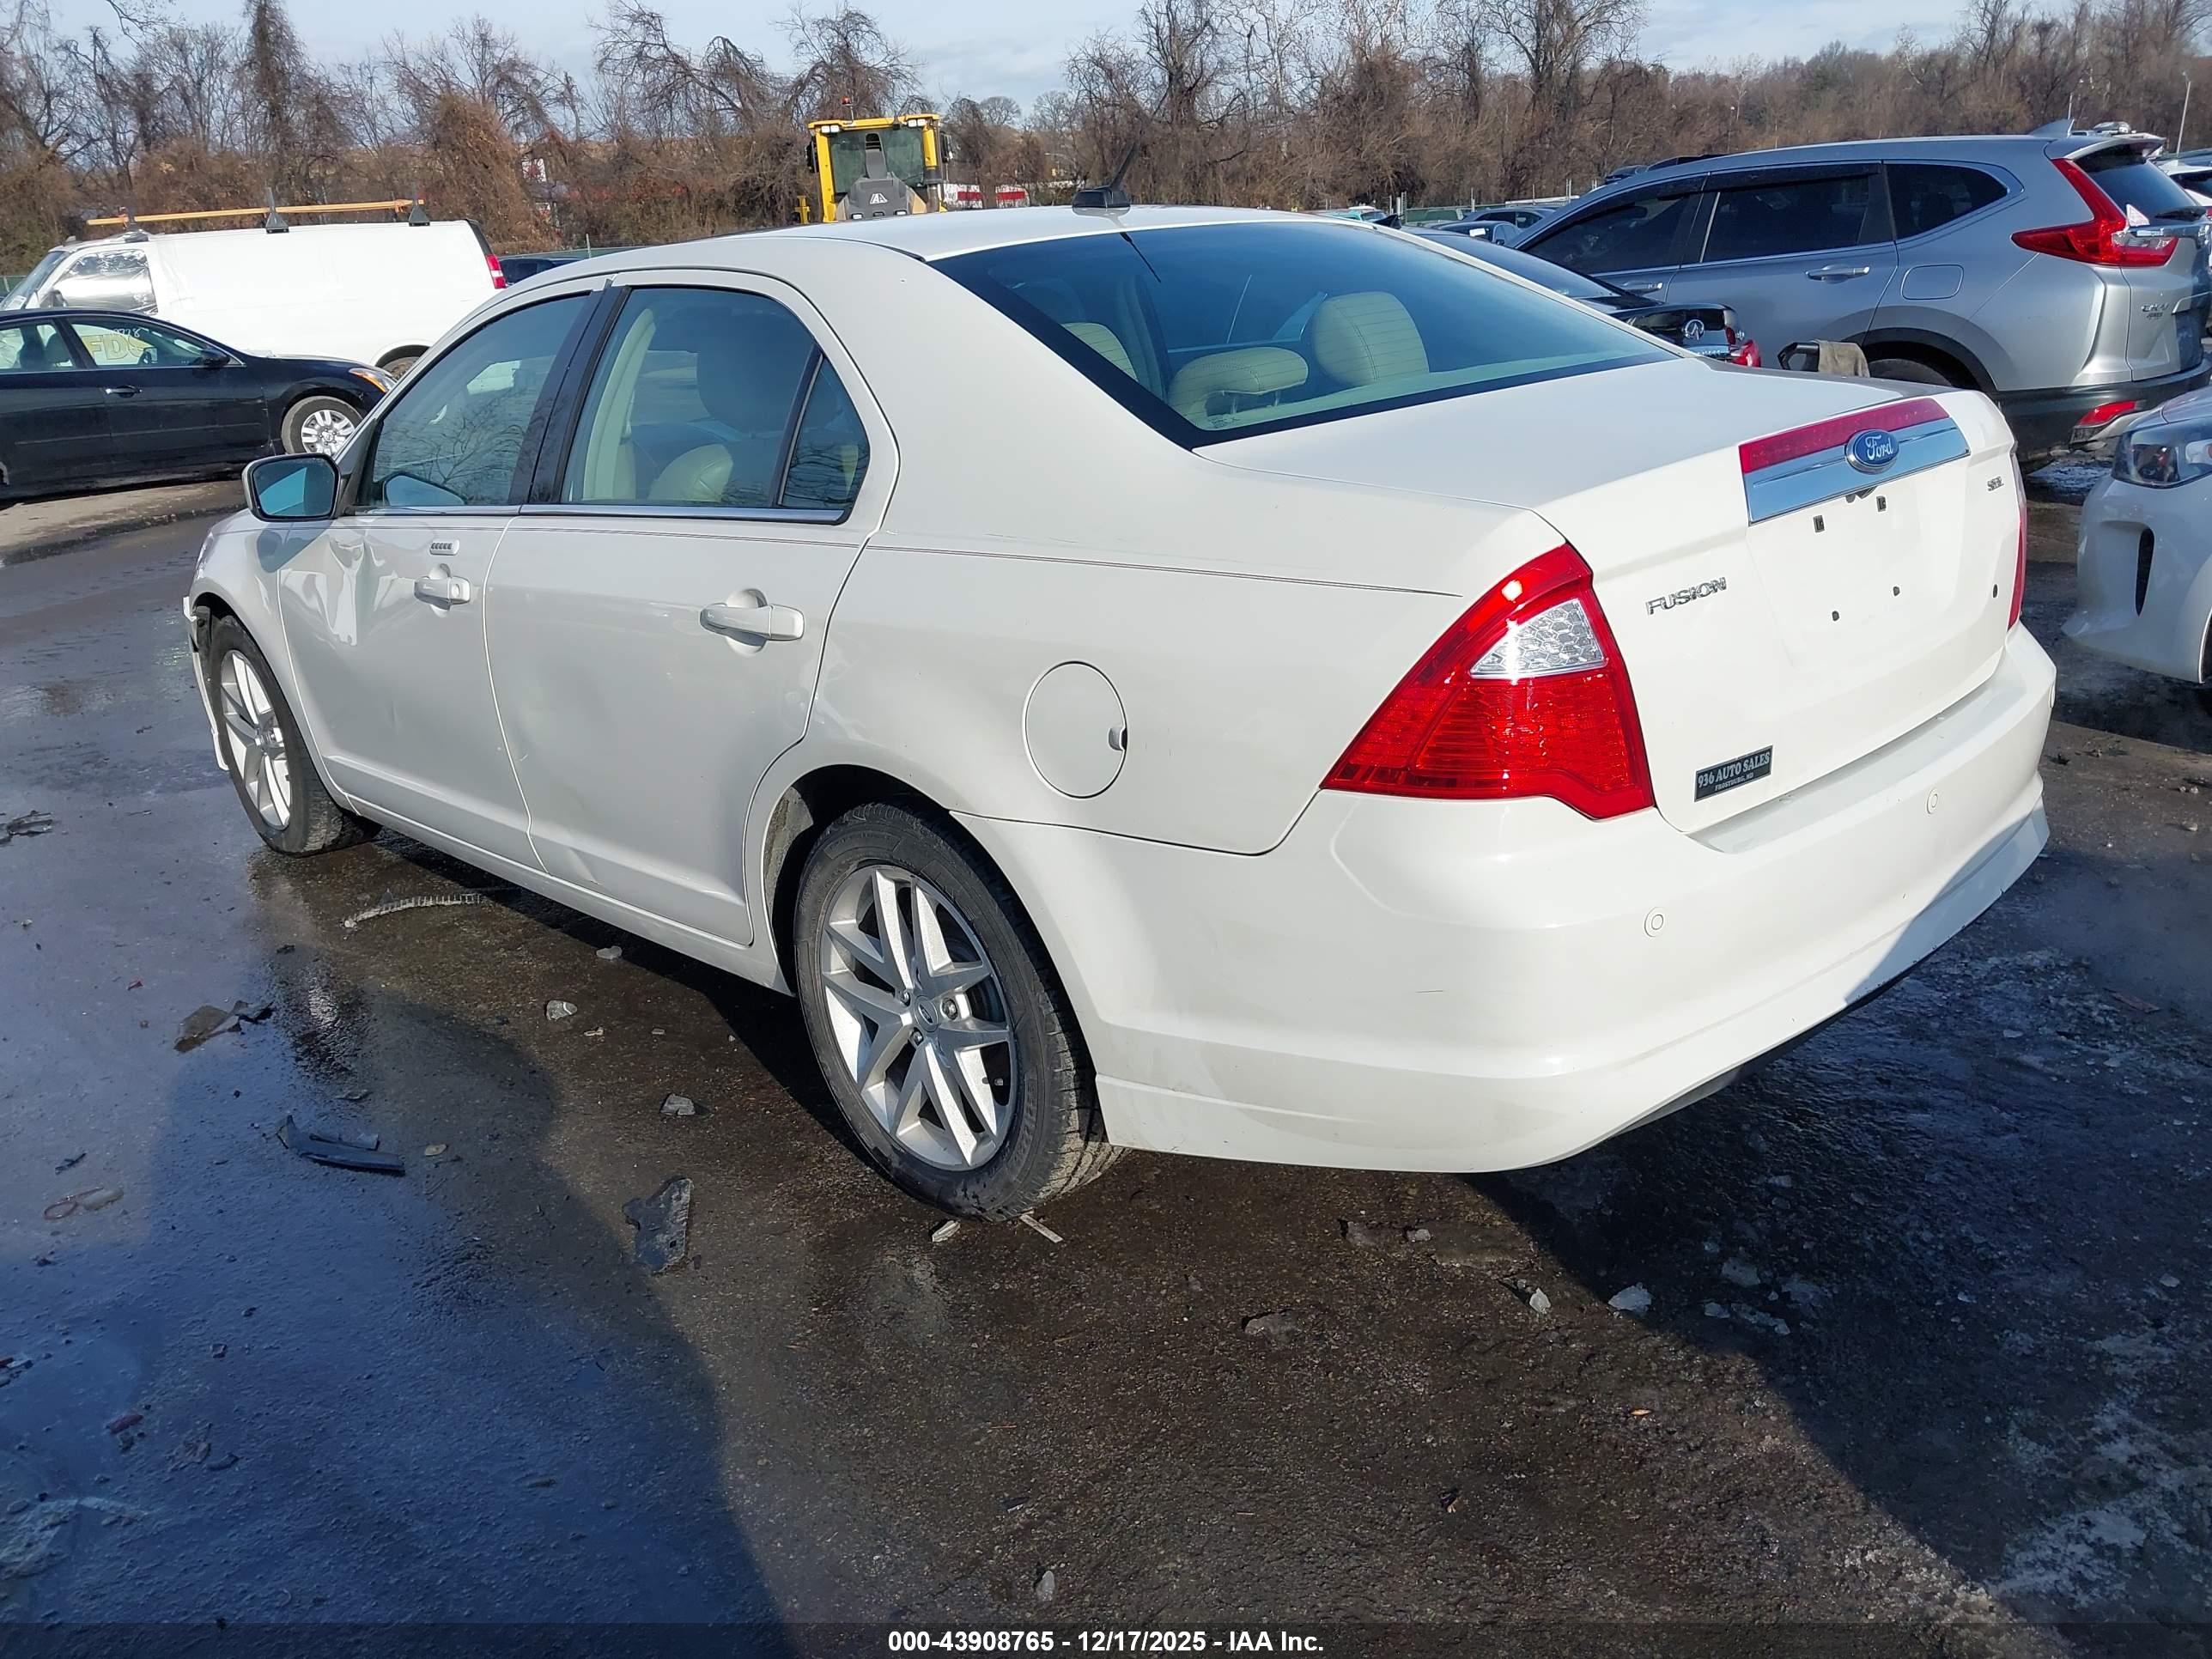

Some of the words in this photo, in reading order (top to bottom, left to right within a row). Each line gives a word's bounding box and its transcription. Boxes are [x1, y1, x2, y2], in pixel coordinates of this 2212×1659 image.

[1865, 434, 1893, 461] Ford
[1645, 576, 1727, 615] FUSION
[1698, 771, 1715, 788] 936
[1716, 762, 1741, 782] AUTO
[1742, 751, 1770, 772] SALES
